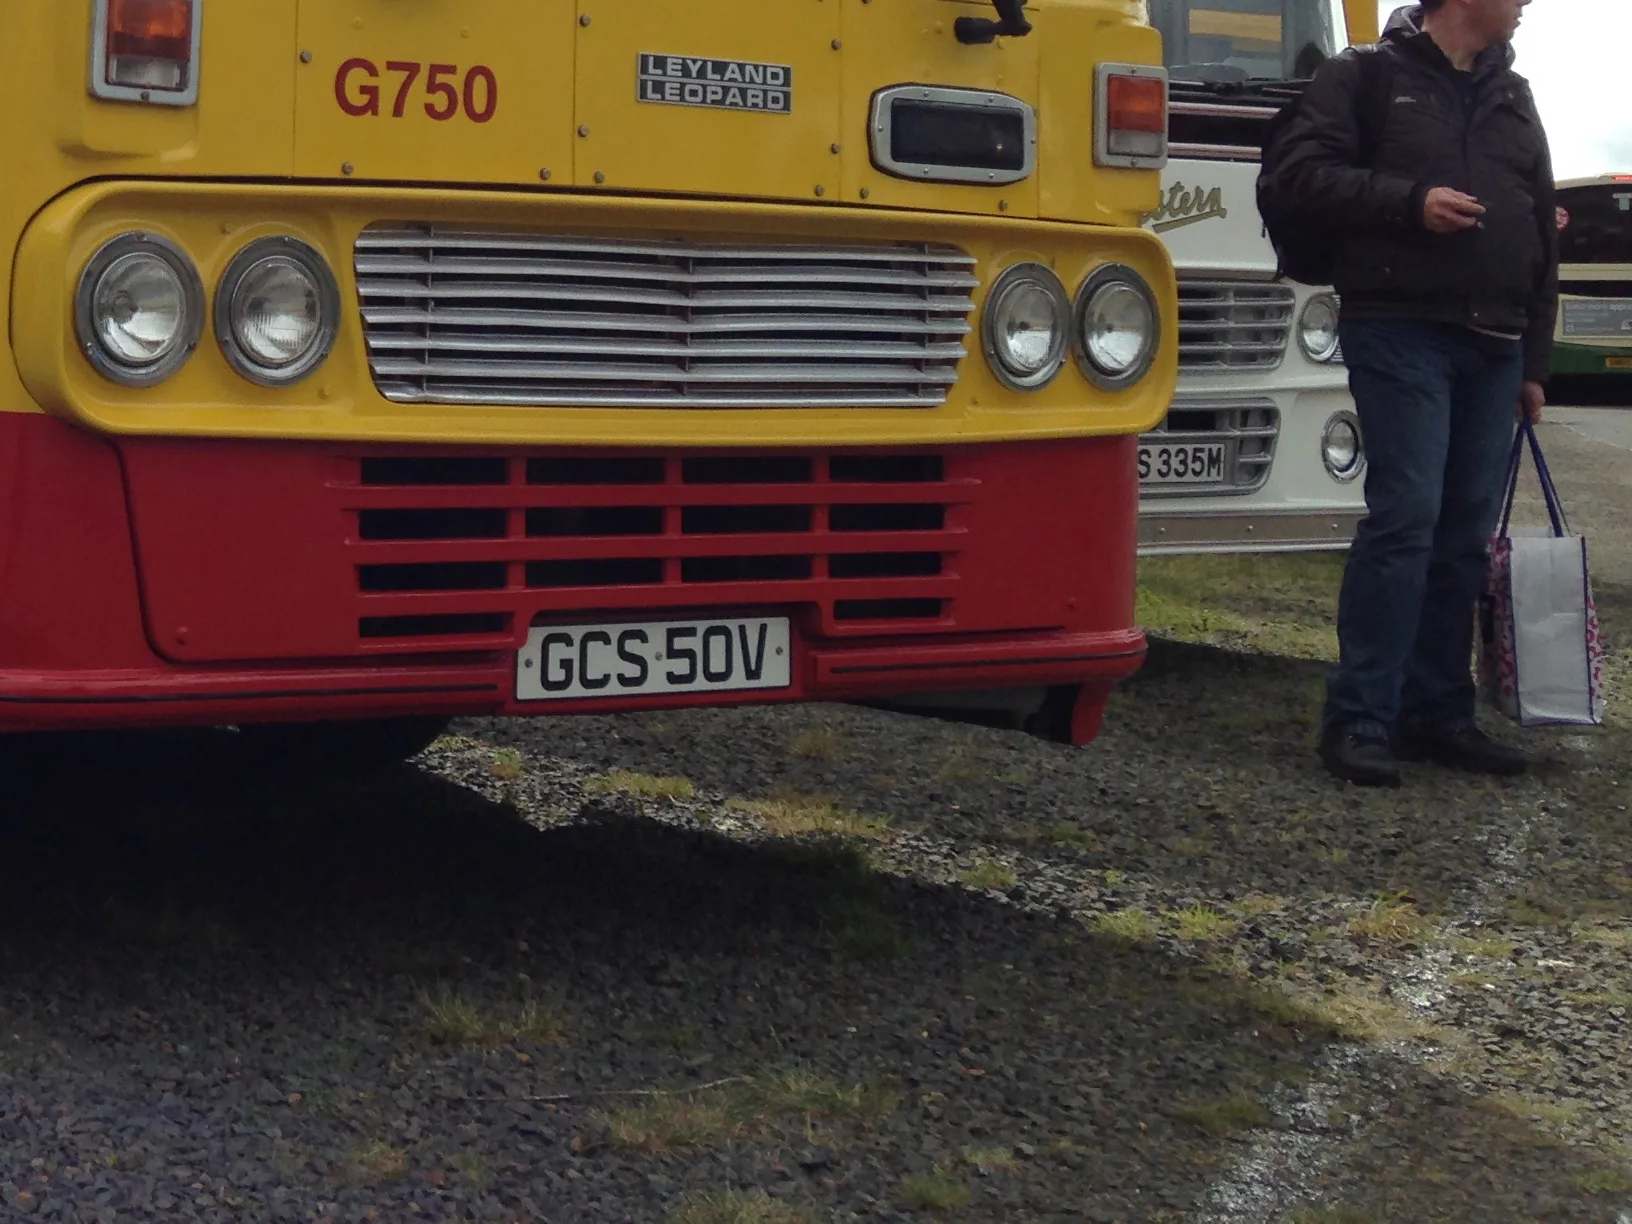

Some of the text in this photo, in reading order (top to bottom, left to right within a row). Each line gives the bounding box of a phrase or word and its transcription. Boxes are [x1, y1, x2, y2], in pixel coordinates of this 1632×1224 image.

[647, 55, 785, 86] LEYLAND
[334, 58, 498, 123] G750
[645, 80, 785, 111] LEOPARD
[1157, 446, 1223, 478] 335M
[540, 623, 768, 692] GCS 50V
